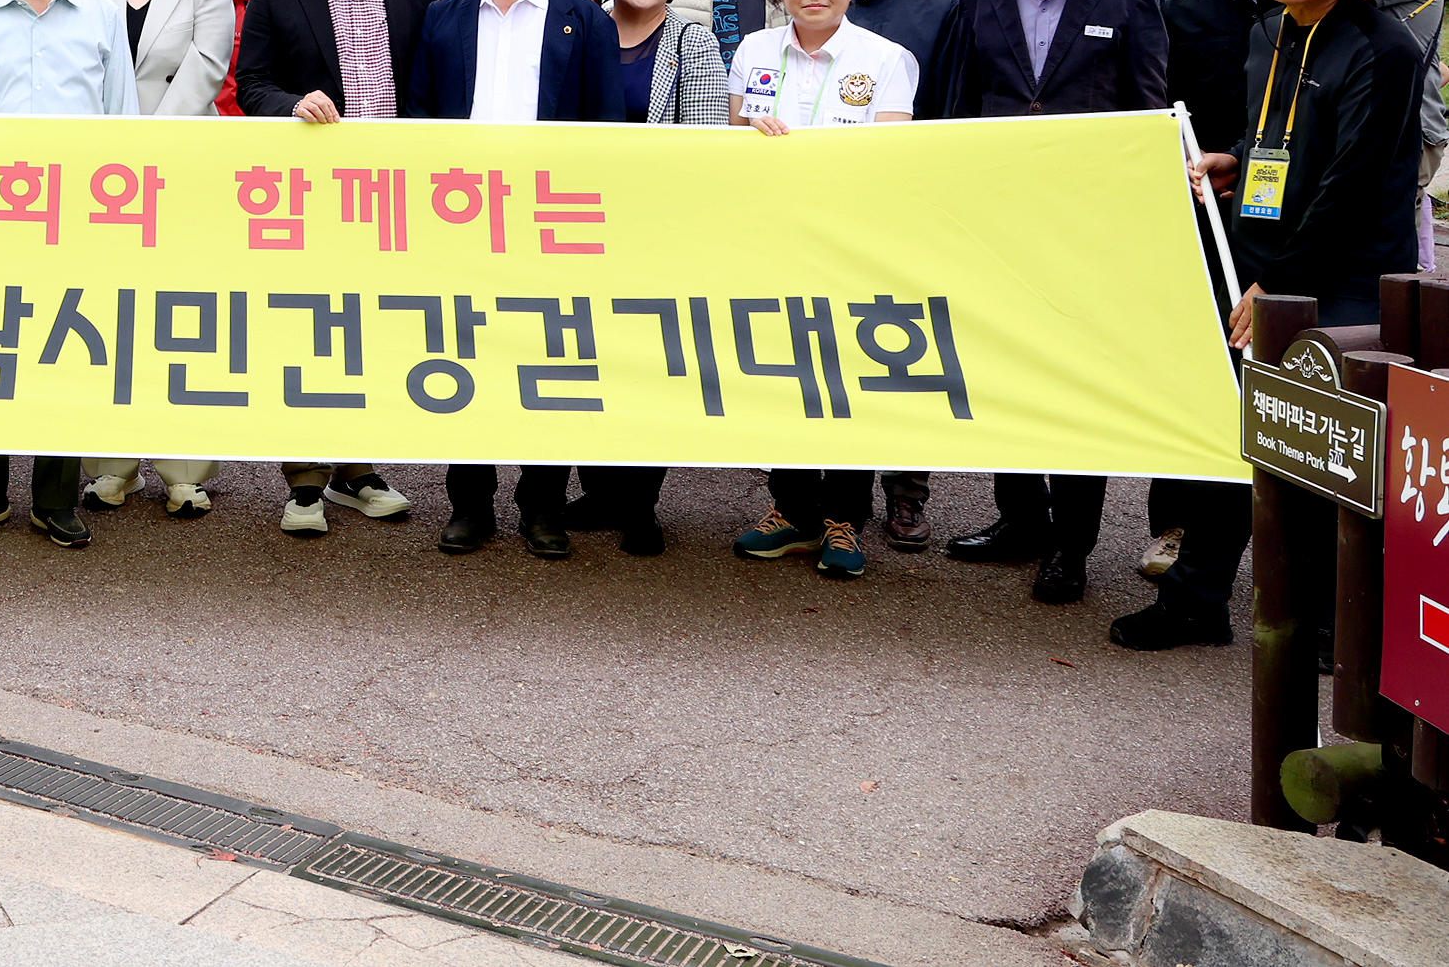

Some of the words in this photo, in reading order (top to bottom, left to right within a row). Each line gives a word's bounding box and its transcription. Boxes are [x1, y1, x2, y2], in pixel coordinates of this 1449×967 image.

[746, 103, 771, 114] 간호사
[234, 165, 606, 255] 함께하는
[1253, 389, 1317, 434] 책테마파크
[1319, 415, 1348, 454] 가는
[1350, 426, 1365, 462] 길
[1256, 431, 1277, 452] Book
[1277, 439, 1304, 464] Theme
[1305, 453, 1326, 472] Park
[1328, 450, 1344, 466] 570
